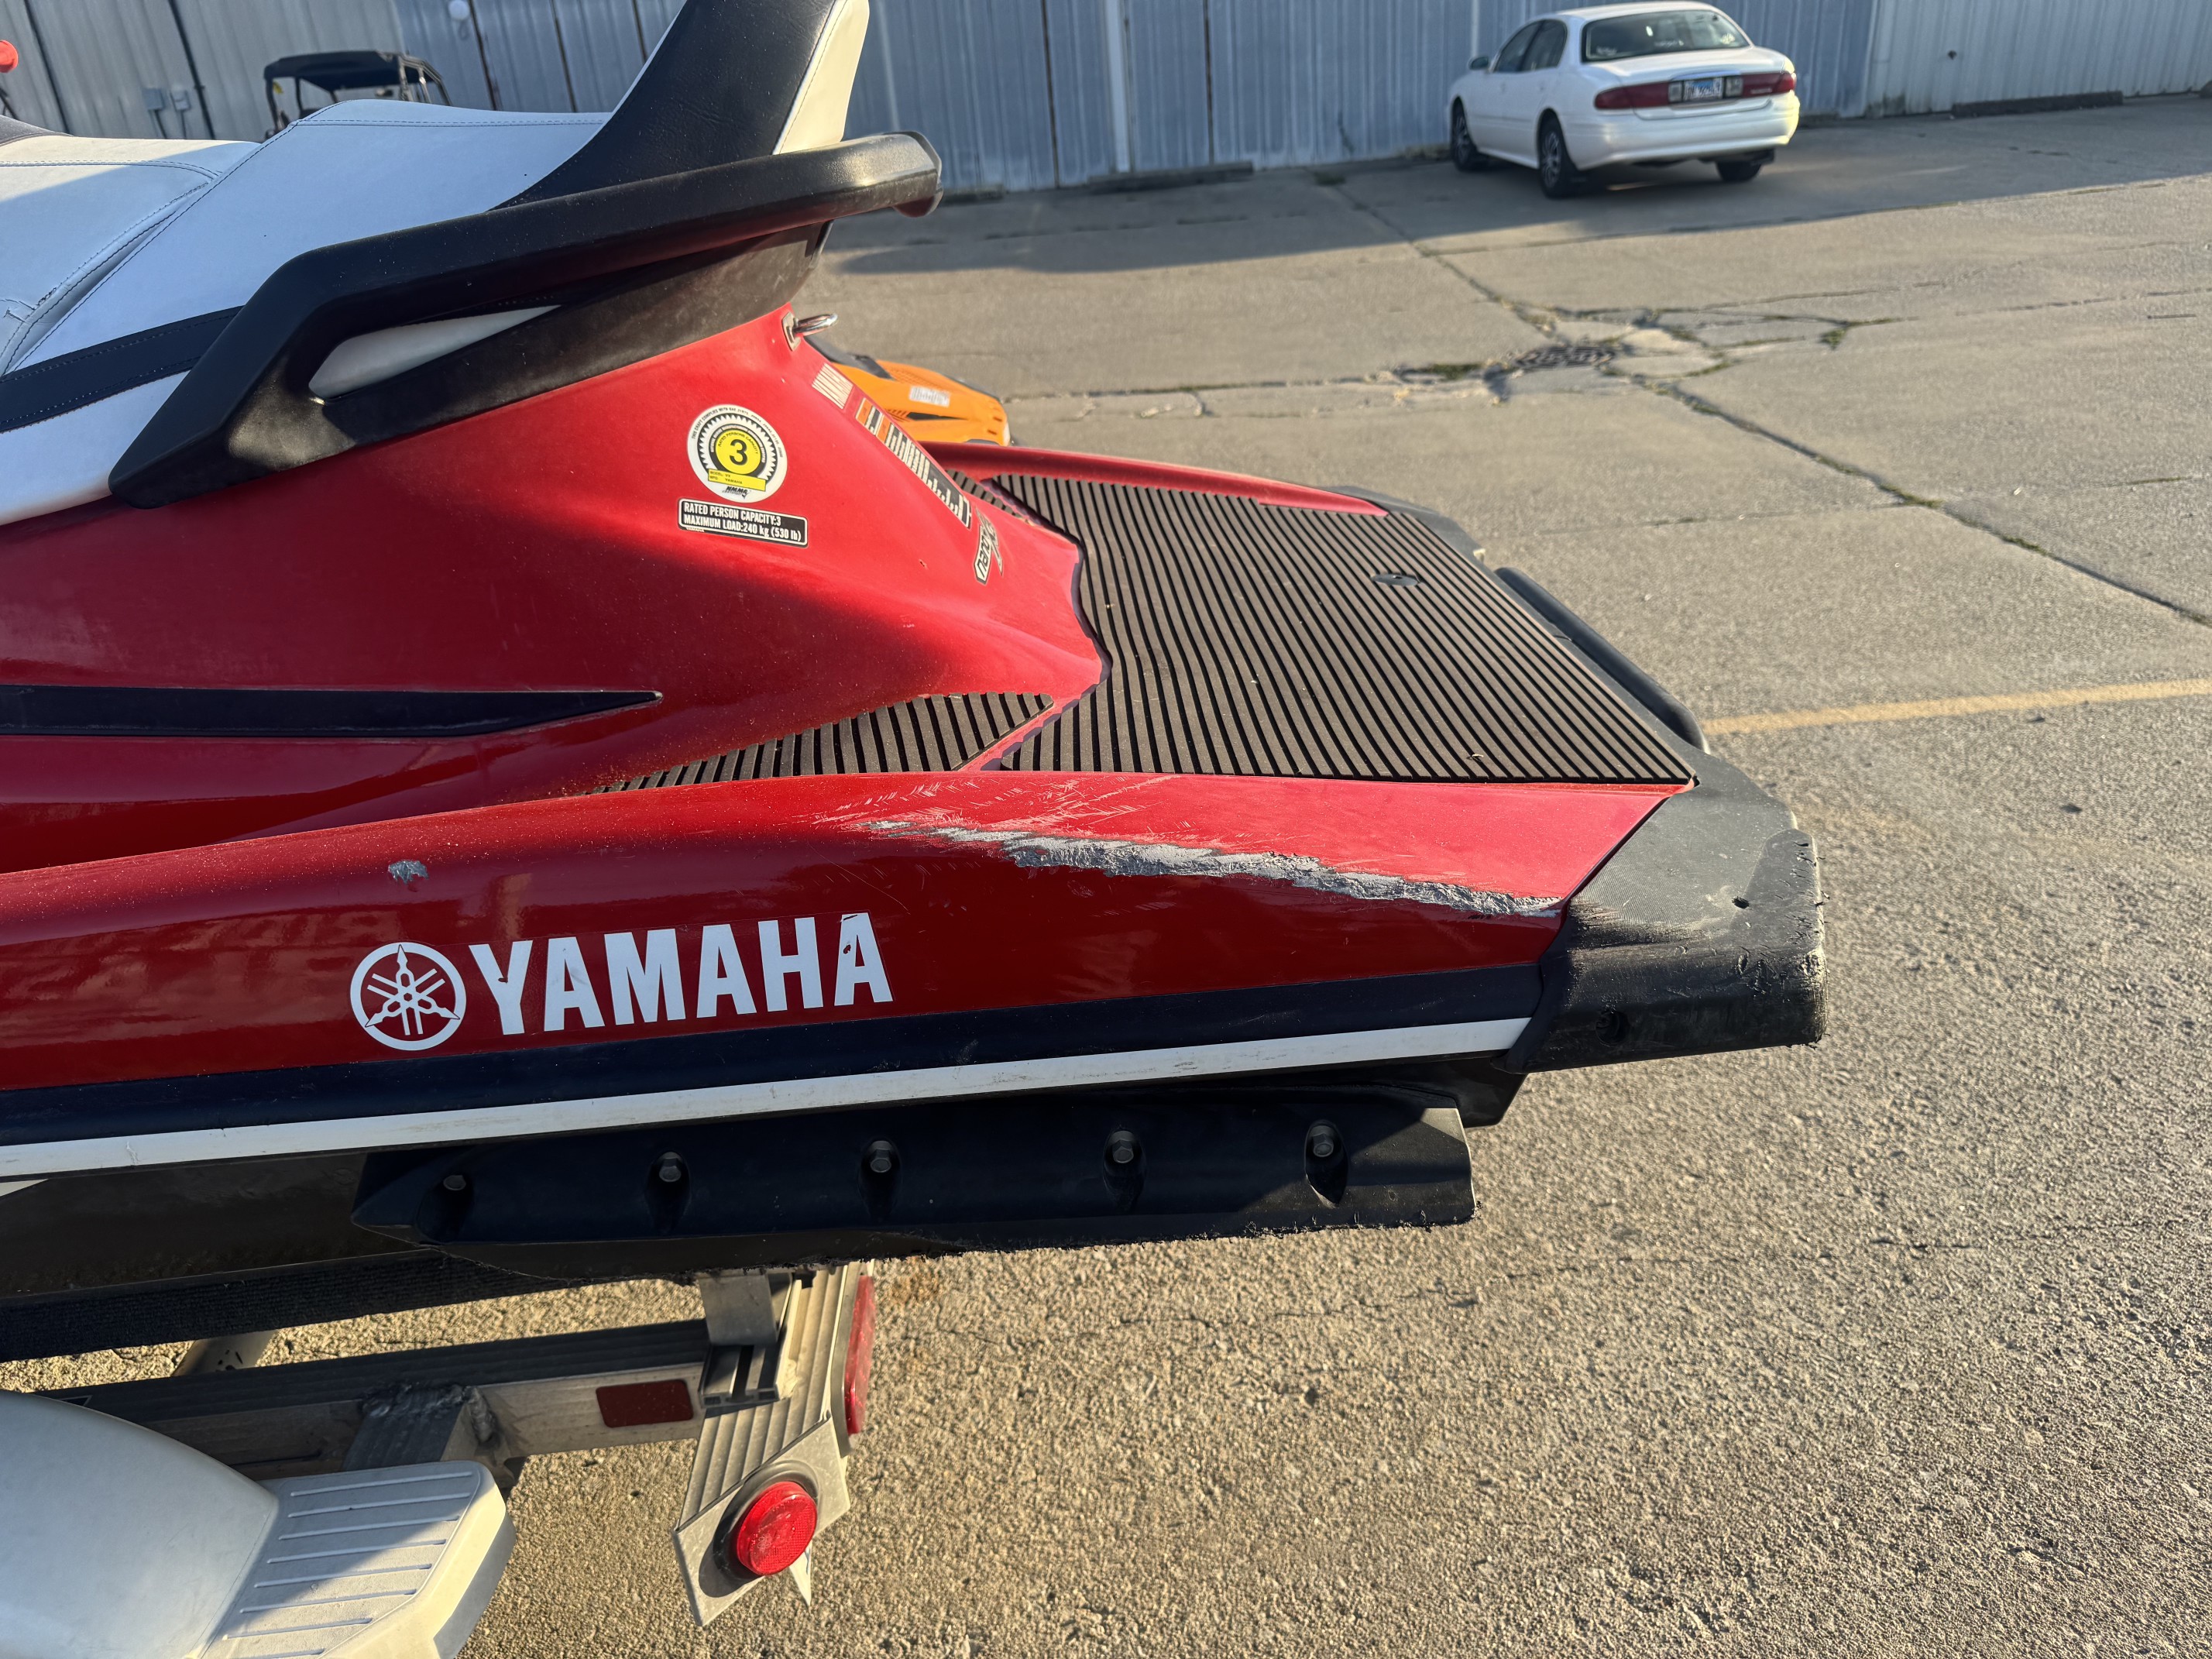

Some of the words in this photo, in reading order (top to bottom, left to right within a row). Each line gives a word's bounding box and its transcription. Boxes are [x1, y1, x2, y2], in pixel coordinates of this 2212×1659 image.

[730, 439, 748, 465] 3
[683, 514, 721, 528] MAXIMUM
[723, 519, 757, 534] LOAD:240
[759, 525, 769, 538] kg
[771, 527, 789, 539] (530
[791, 531, 802, 541] lb)
[684, 502, 709, 515] RATED
[709, 506, 739, 520] PERSON
[740, 510, 781, 527] CAPACITY:3
[468, 911, 895, 1036] YAMAHA
